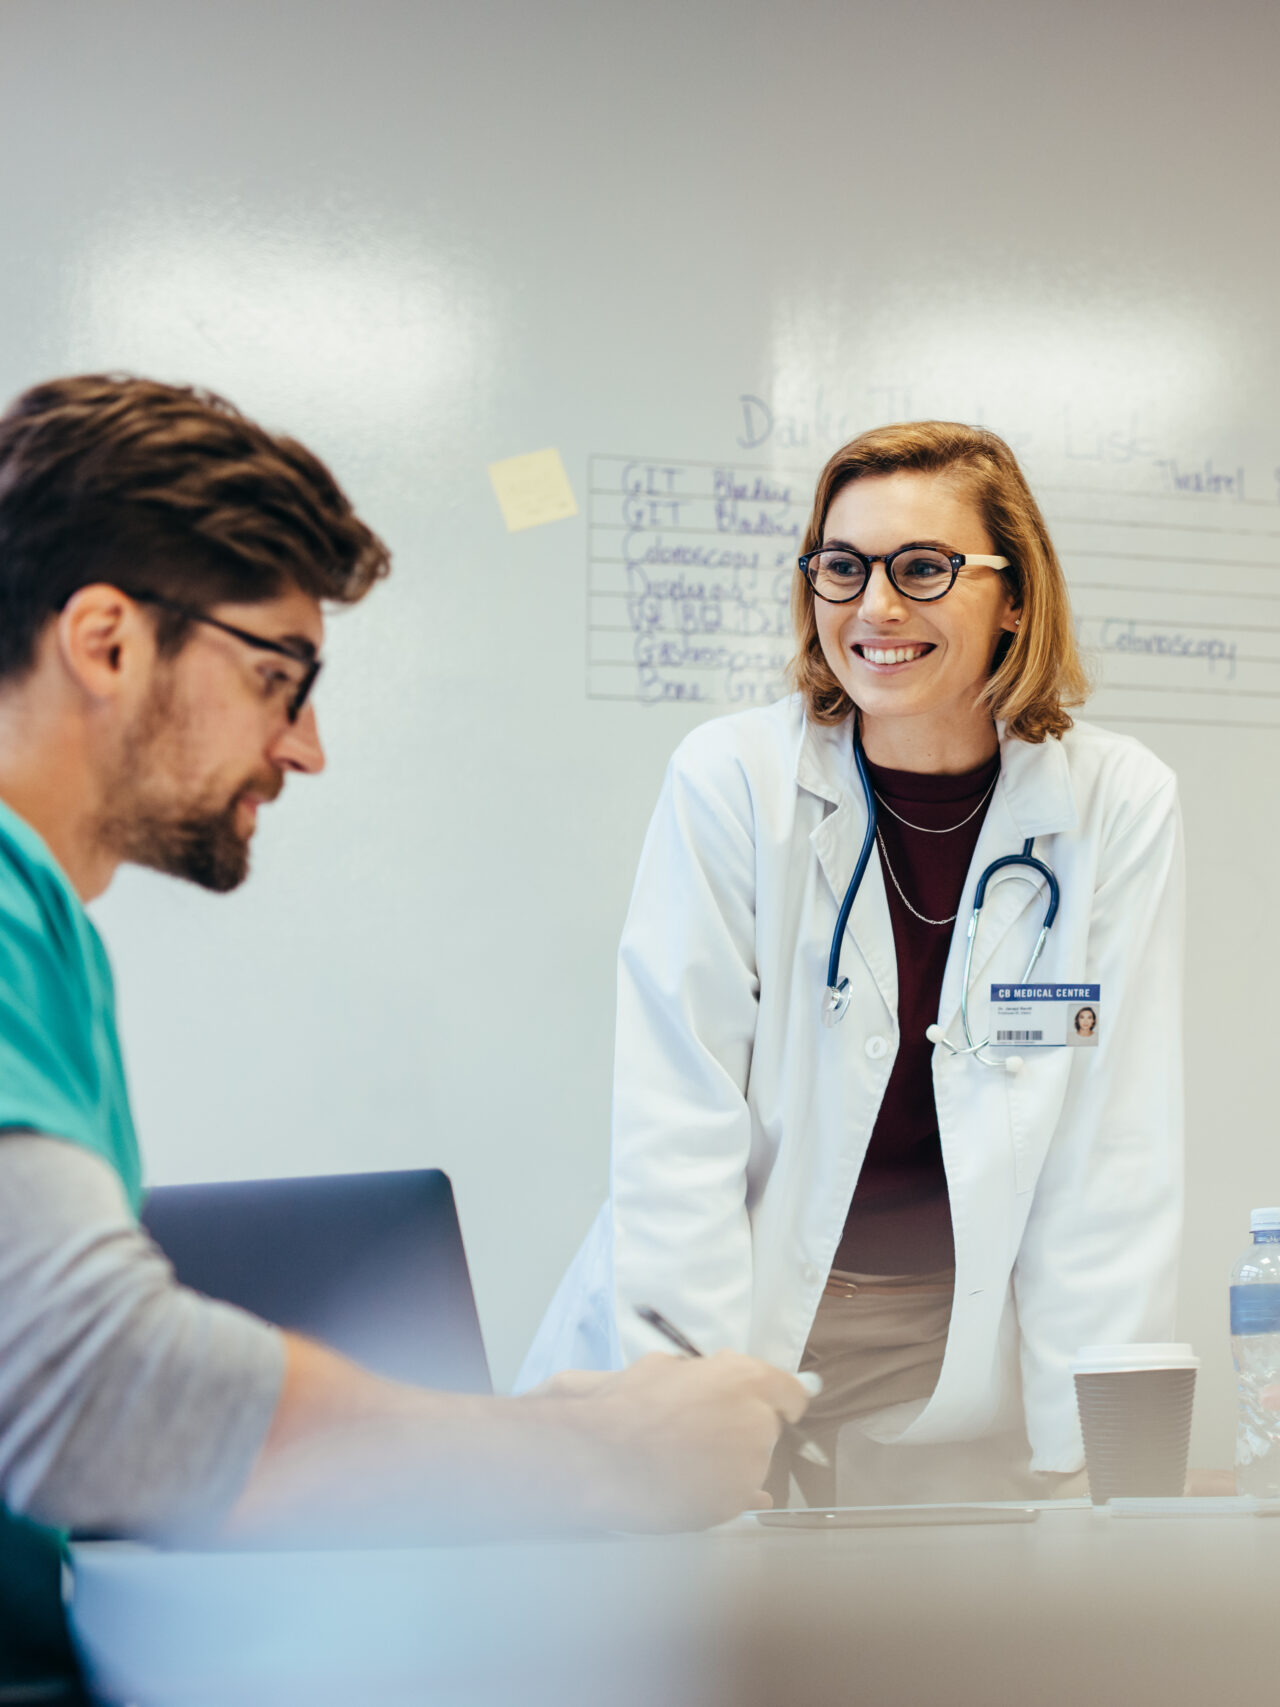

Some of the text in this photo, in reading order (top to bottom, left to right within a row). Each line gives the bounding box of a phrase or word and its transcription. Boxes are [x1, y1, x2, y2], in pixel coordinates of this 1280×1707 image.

[621, 460, 684, 497] GIT
[998, 988, 1091, 999] CB MEDICAL CENTRE
